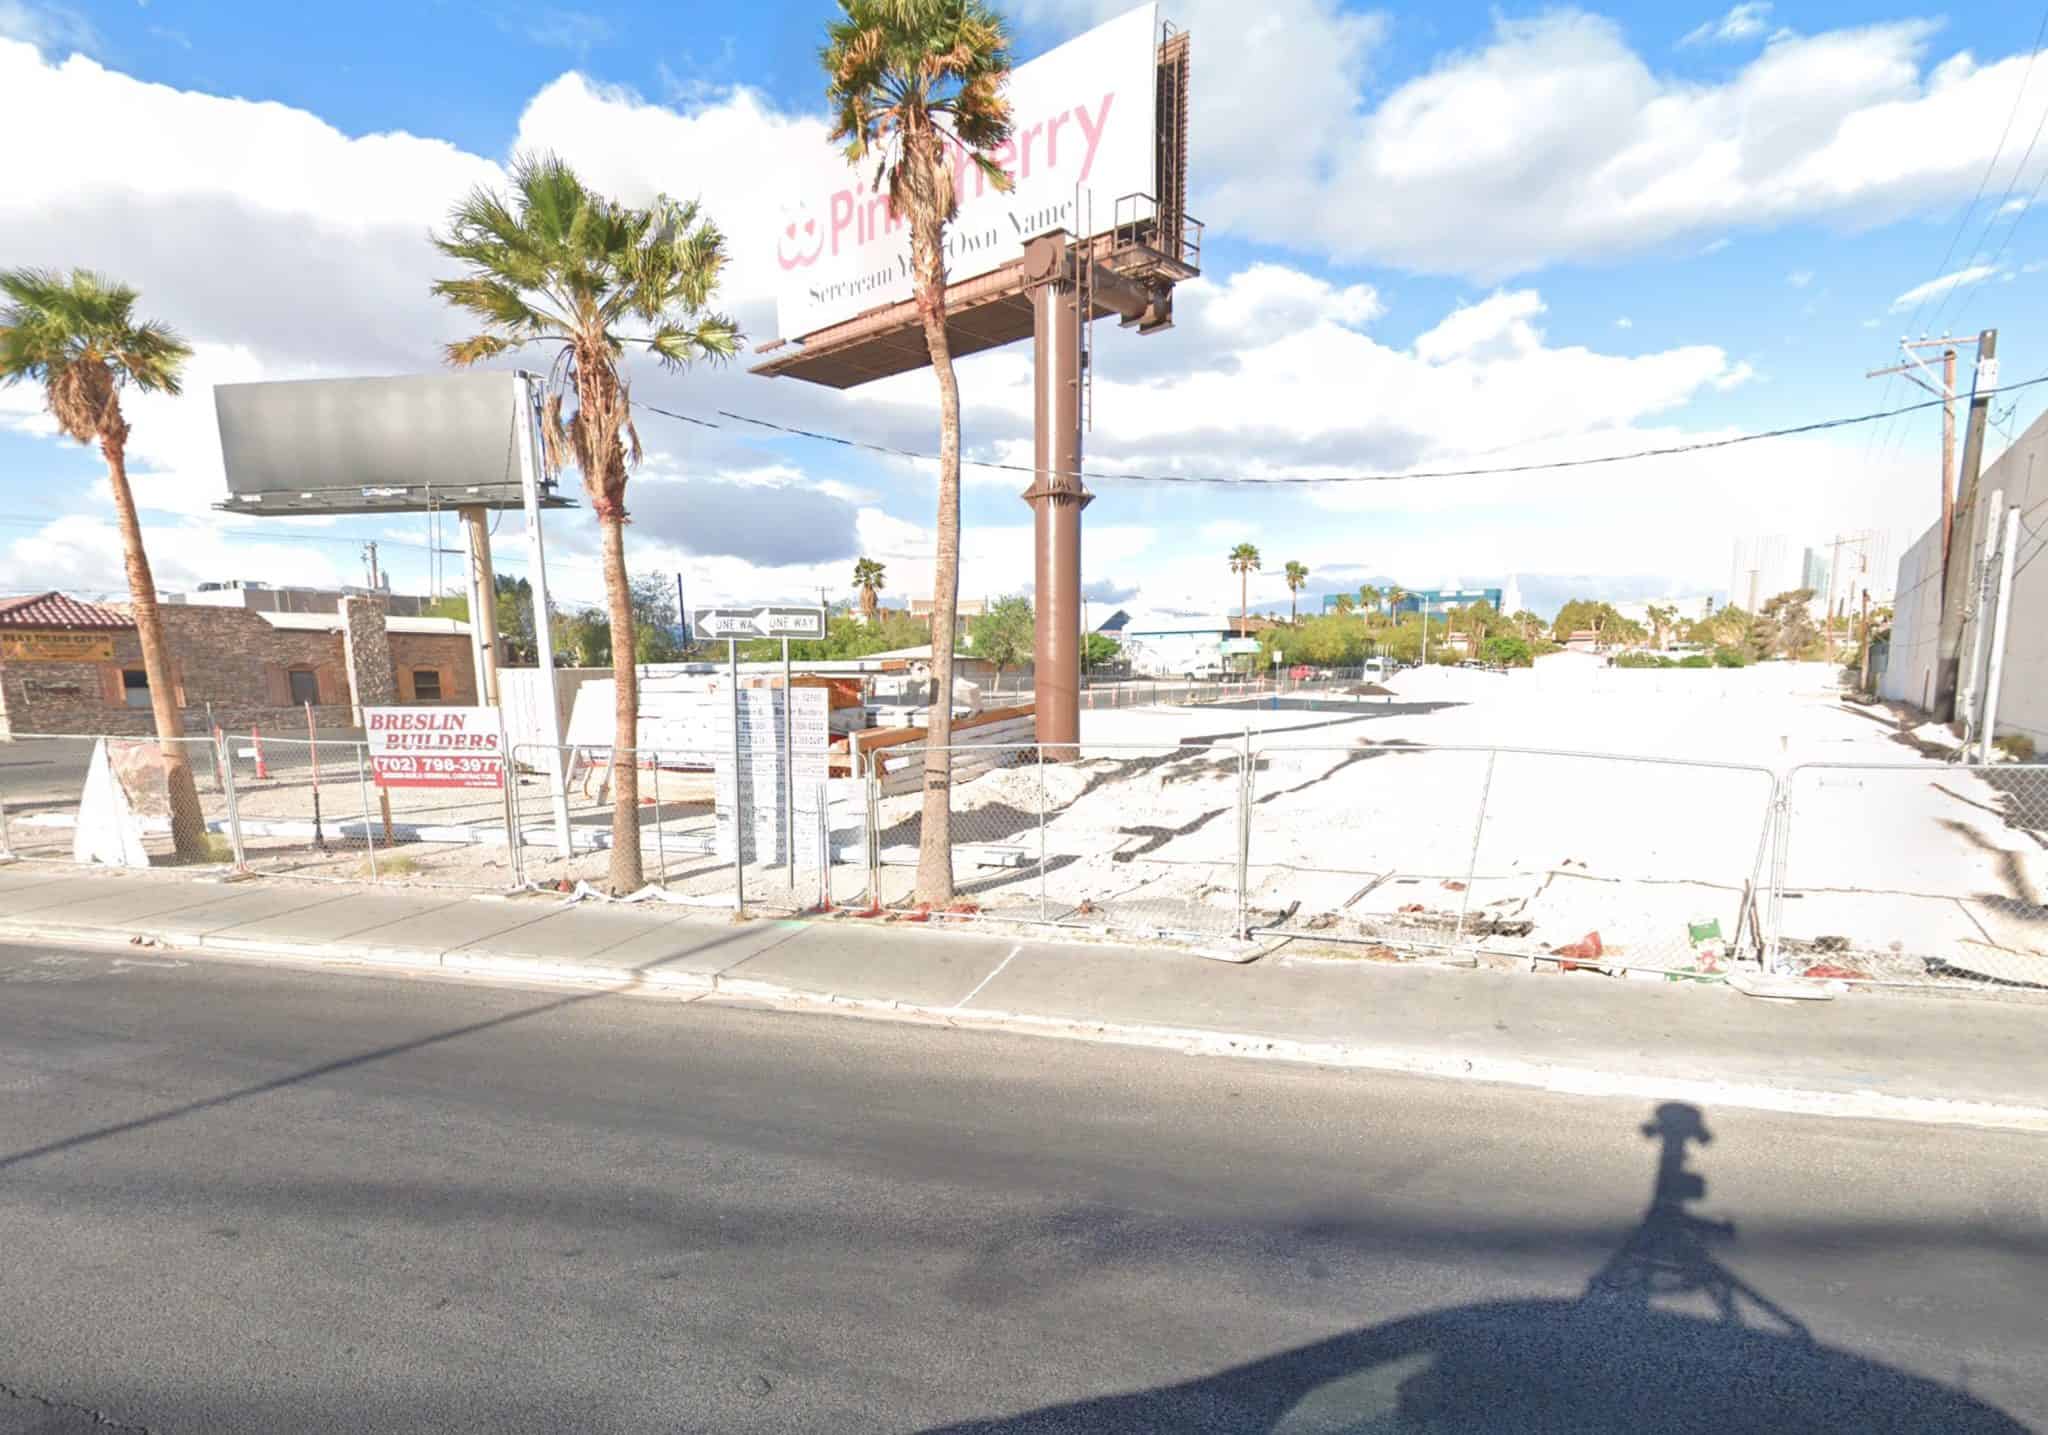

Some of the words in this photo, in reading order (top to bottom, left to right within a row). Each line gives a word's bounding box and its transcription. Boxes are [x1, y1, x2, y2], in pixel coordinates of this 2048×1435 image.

[740, 620, 753, 632] WA
[794, 616, 815, 629] WAY
[369, 713, 466, 731] BRESLIN
[385, 733, 499, 751] BUILDERS
[373, 757, 418, 773] (702)
